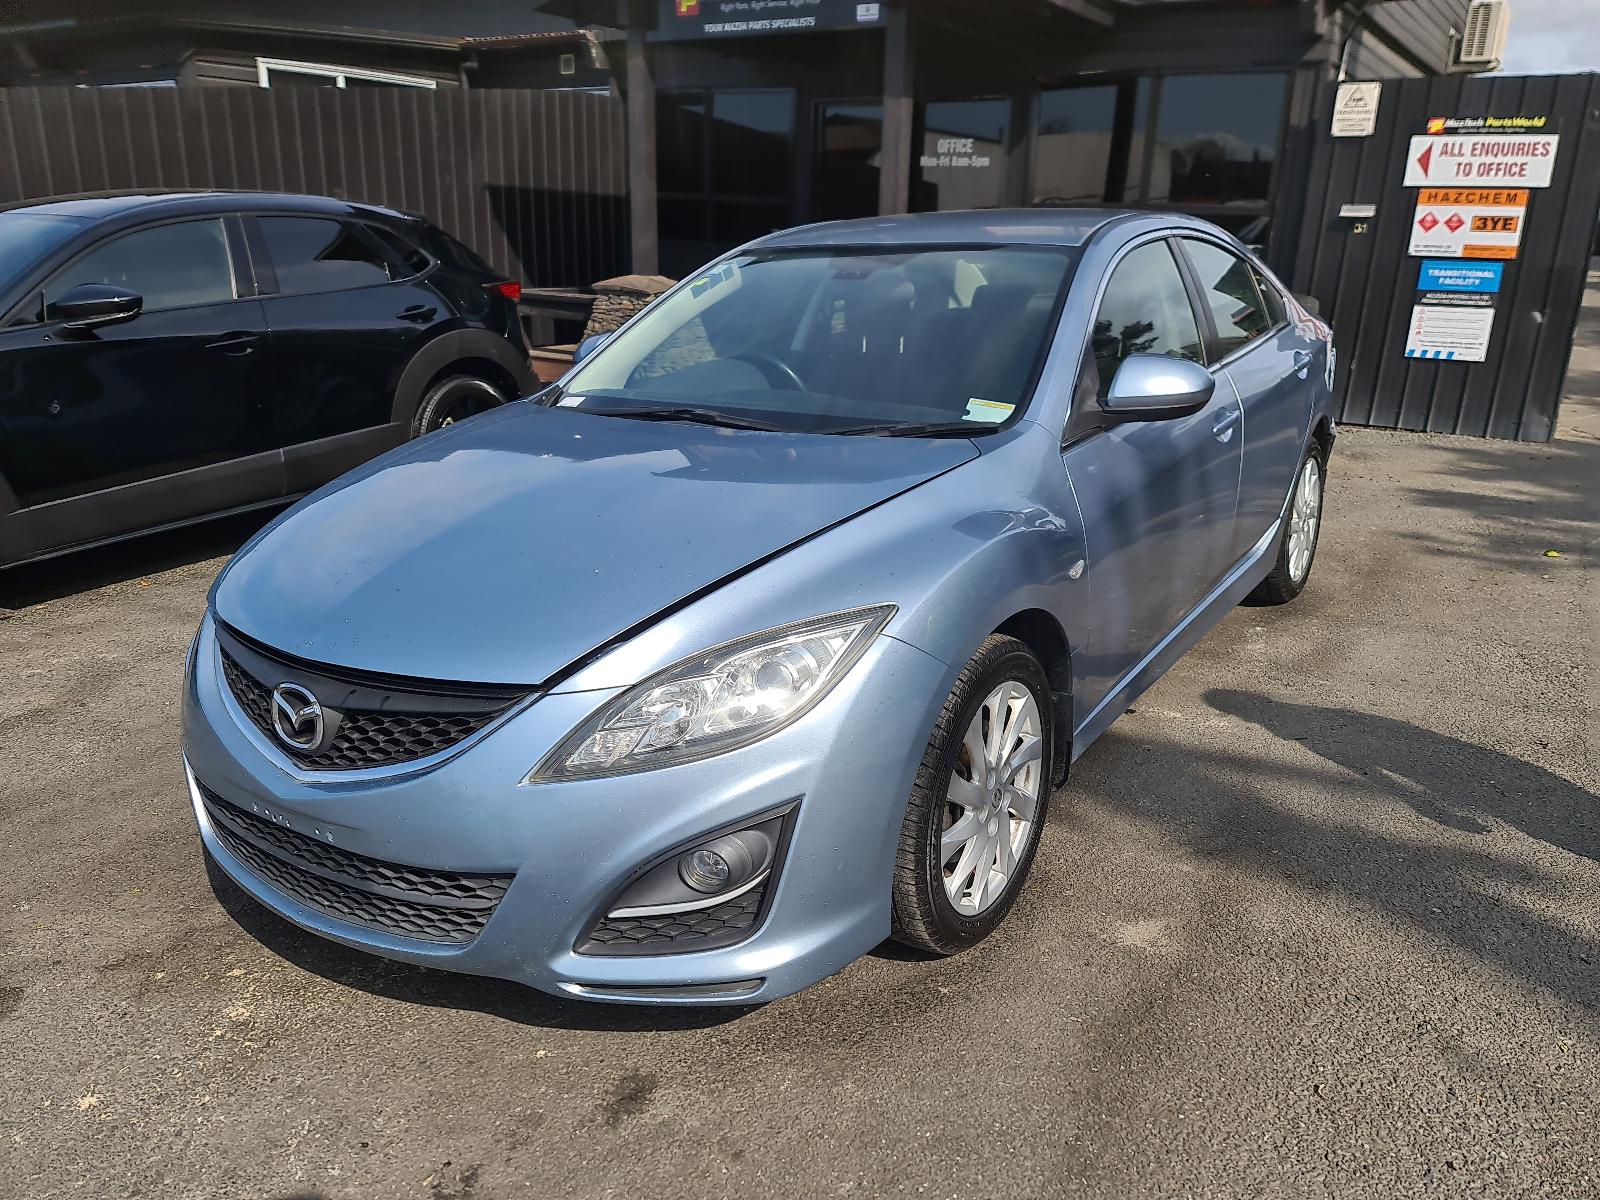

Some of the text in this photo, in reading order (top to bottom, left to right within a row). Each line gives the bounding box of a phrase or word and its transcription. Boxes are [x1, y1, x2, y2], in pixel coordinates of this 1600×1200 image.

[704, 17, 816, 32] YOUR MAZDA PARTS SPECIALISTS
[937, 138, 974, 153] OFFICE
[1439, 141, 1551, 158] ALL ENQUIRIES
[1455, 162, 1529, 178] TO OFFICE
[1427, 192, 1519, 204] HAZCHEM
[1428, 269, 1495, 278] TRANSITIONAL
[1438, 277, 1482, 286] FACILITY
